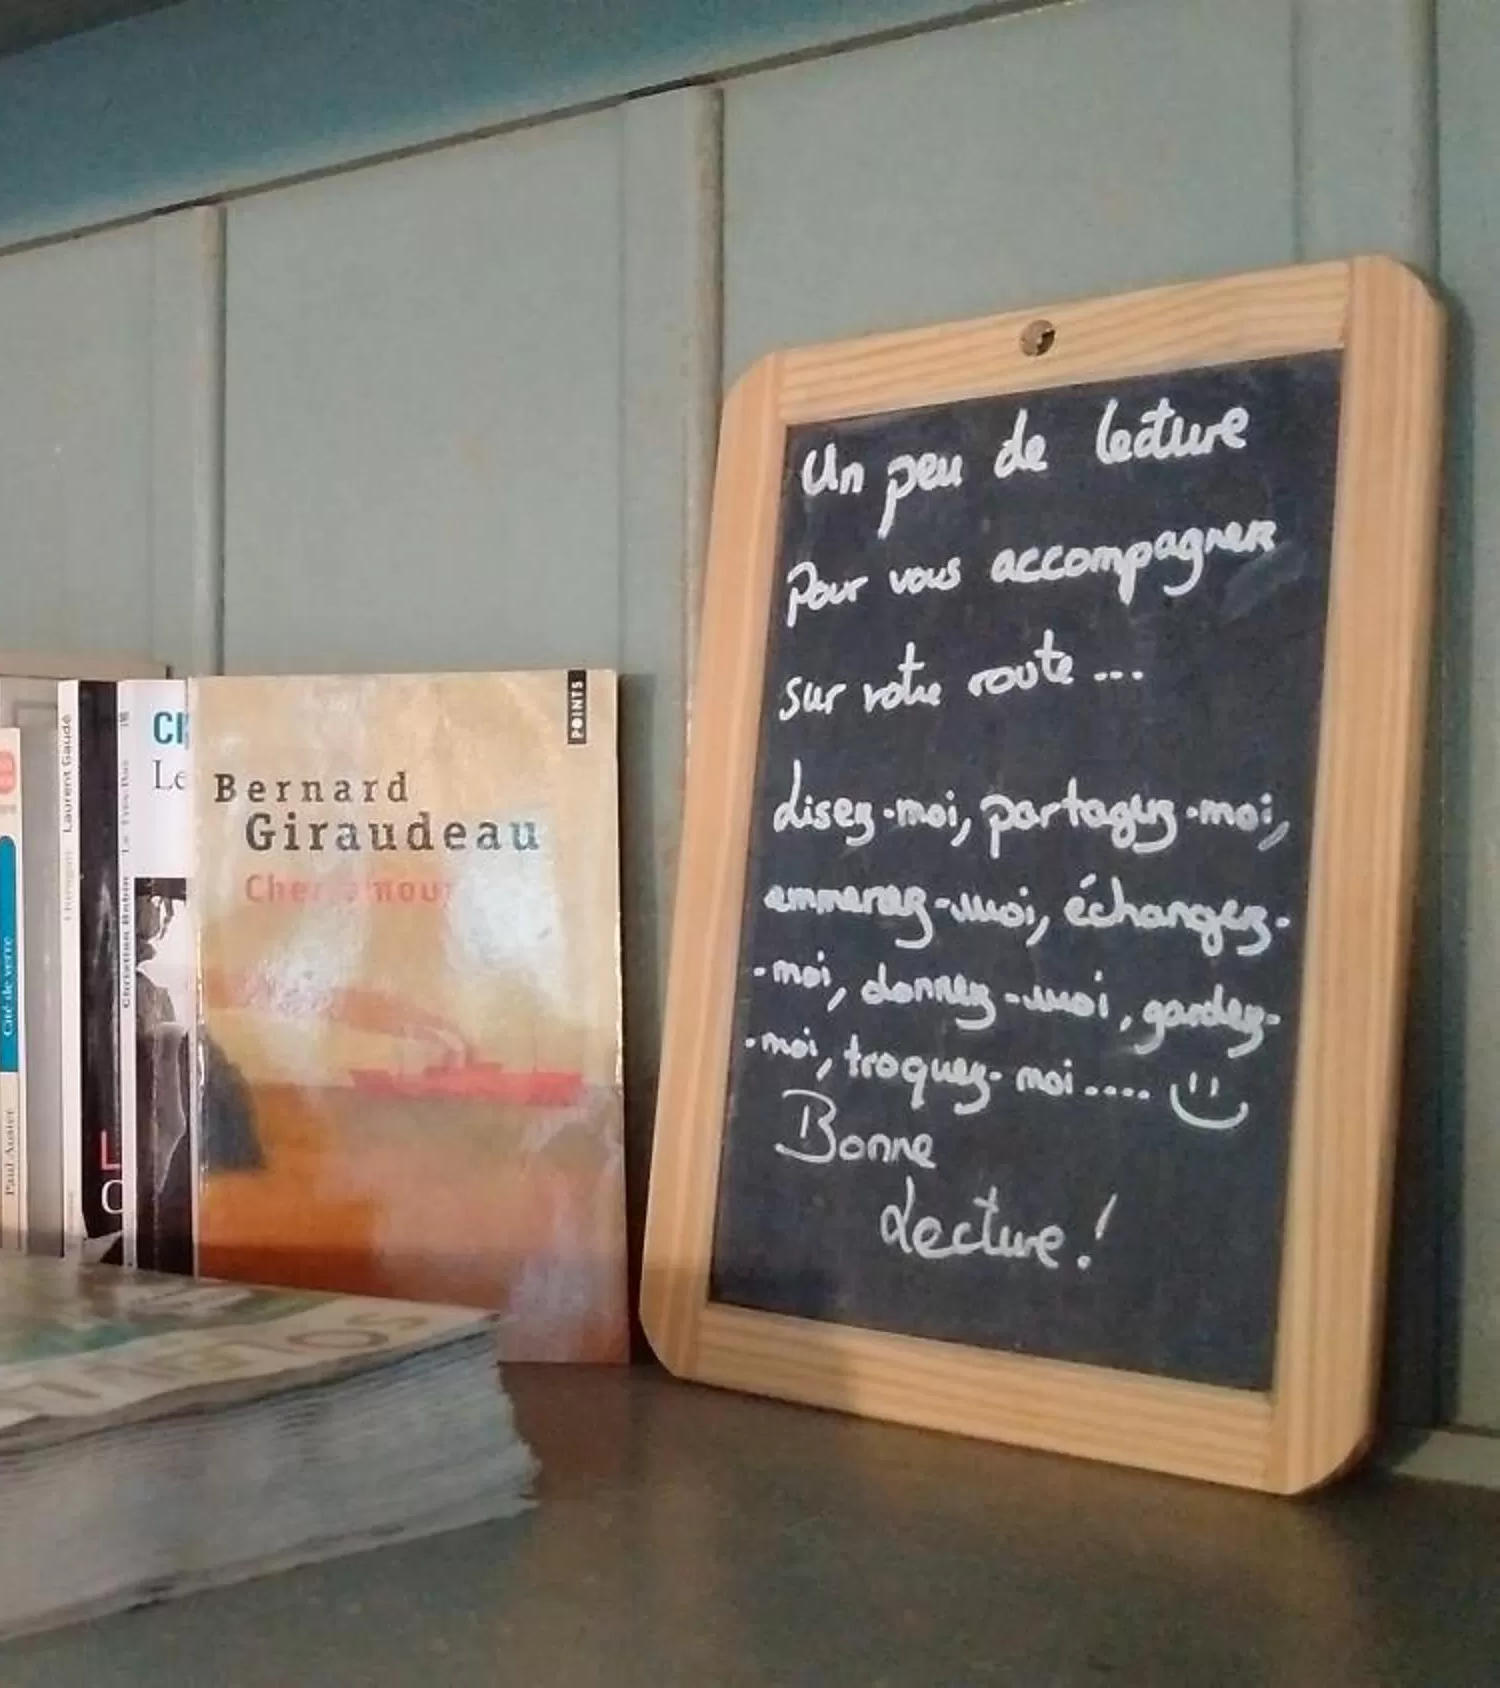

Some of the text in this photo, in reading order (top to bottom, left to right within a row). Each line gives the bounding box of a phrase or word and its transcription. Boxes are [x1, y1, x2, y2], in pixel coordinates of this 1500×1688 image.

[801, 443, 864, 496] Un
[878, 452, 963, 540] peu
[993, 408, 1048, 479] de
[889, 556, 962, 596] vous
[779, 676, 846, 722] sur
[864, 641, 942, 712] votre
[571, 681, 584, 739] POINTS
[60, 714, 72, 767] Gaudé
[62, 769, 73, 834] Laurent
[213, 772, 409, 803] Bernard
[245, 812, 541, 852] Giraudeau
[1, 980, 13, 1001] de
[774, 1088, 937, 1170] Bonne
